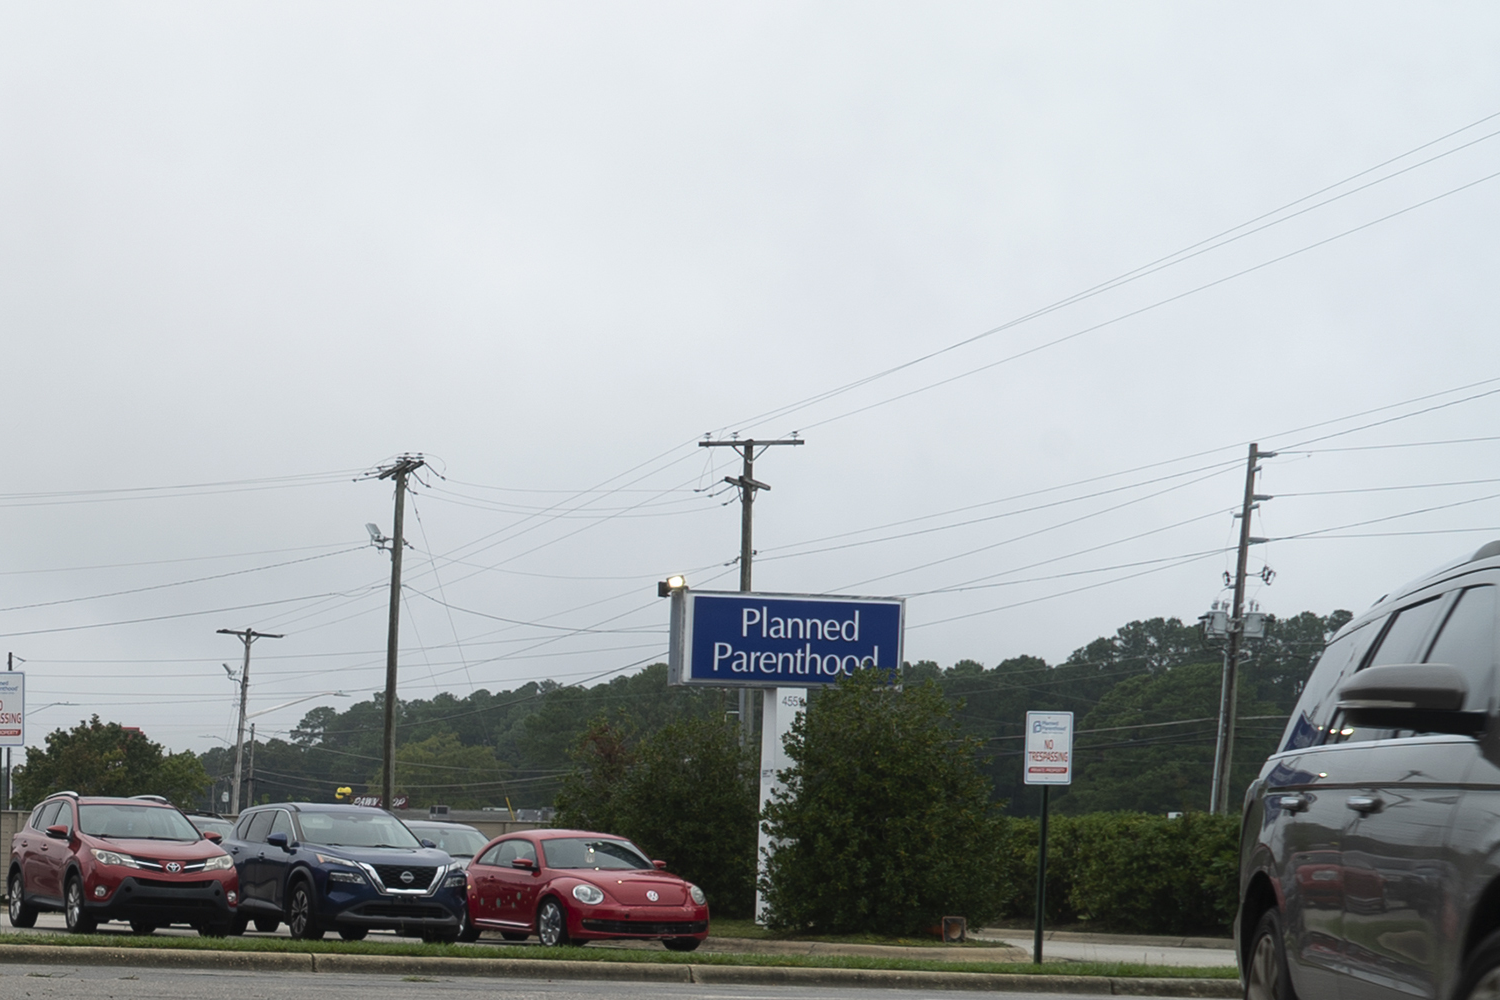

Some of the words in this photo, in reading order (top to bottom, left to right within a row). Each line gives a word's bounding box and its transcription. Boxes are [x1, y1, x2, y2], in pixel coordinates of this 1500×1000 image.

[742, 606, 860, 642] Planned
[713, 642, 879, 676] Parenthood
[1044, 739, 1054, 750] NO
[1028, 751, 1068, 762] TRESPASSING
[352, 797, 380, 806] PAWN
